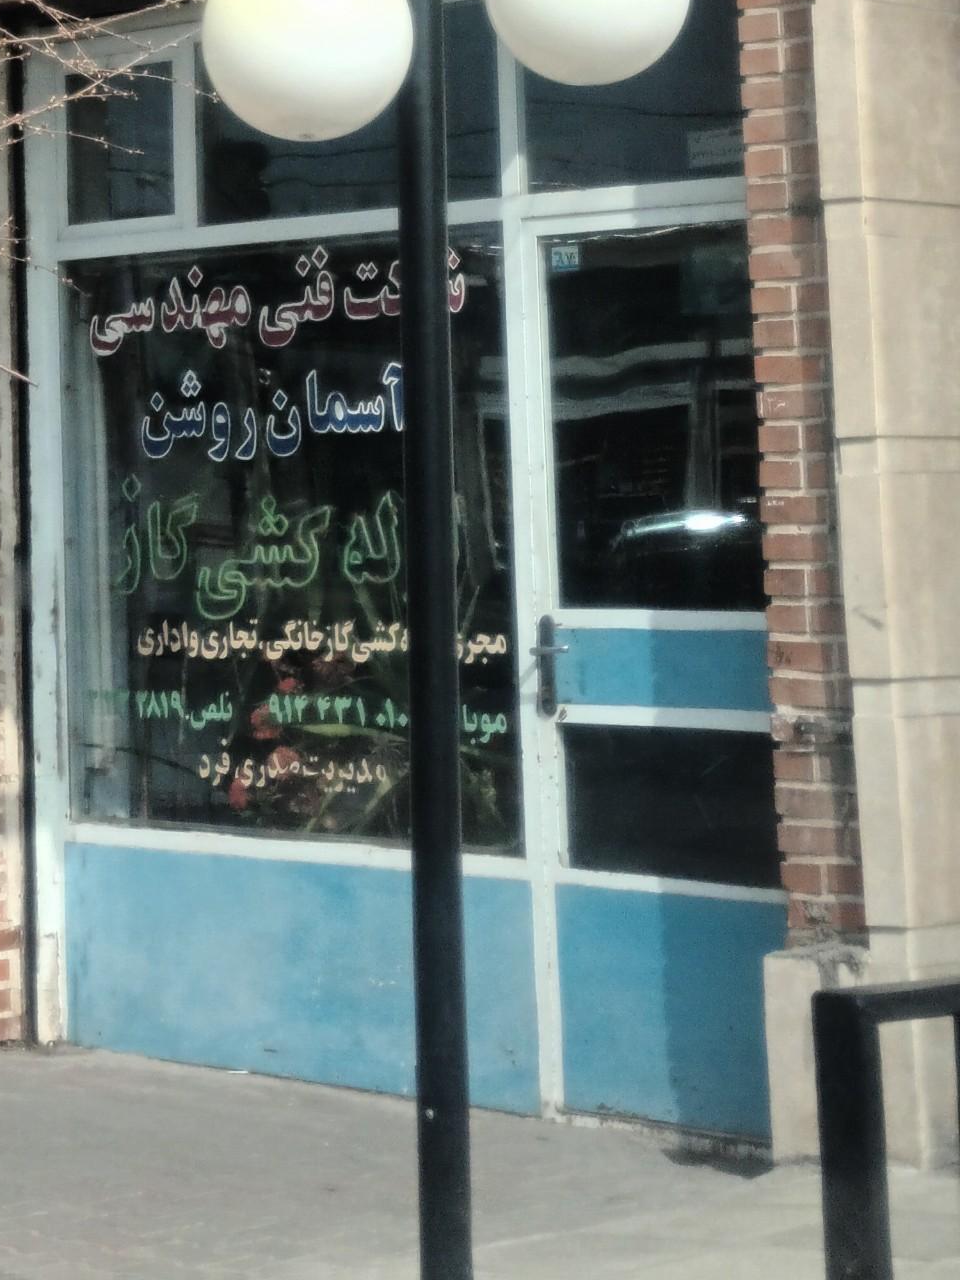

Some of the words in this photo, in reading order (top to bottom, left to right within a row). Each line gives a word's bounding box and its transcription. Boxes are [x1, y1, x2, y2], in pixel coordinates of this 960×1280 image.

[90, 264, 251, 355] مهندسی
[259, 245, 334, 346] فنی
[141, 369, 257, 461] روشن
[196, 494, 333, 619] کشی
[201, 619, 257, 659] تجاری
[199, 738, 231, 786] فرد
